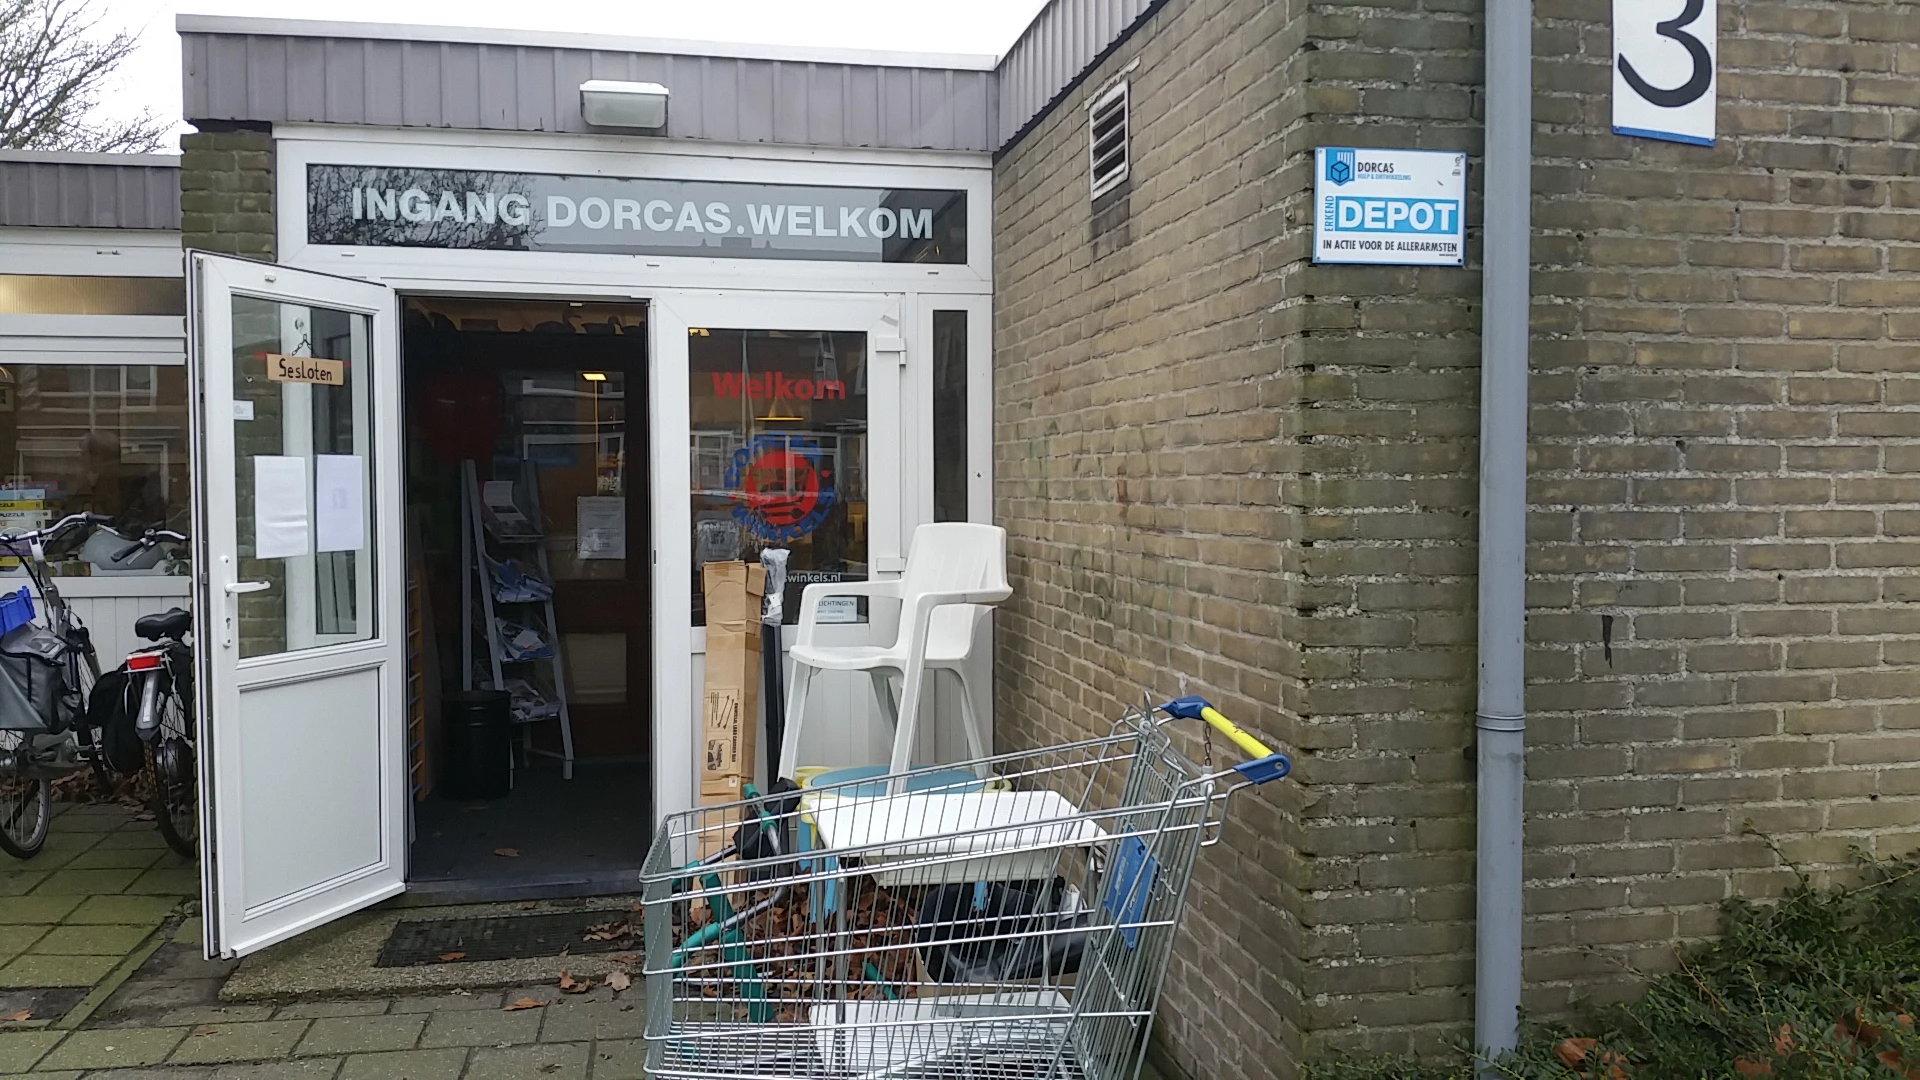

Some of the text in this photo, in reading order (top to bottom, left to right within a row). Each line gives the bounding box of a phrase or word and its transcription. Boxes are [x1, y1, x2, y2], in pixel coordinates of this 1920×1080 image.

[1618, 0, 1712, 108] 3
[1357, 162, 1394, 173] DORCAS
[352, 187, 531, 226] INGANG
[1324, 195, 1335, 232] ERKEND
[1339, 199, 1456, 230] DEPOT
[1323, 239, 1458, 252] IN ACTIE VOOR DE ALLERARMSTEN
[711, 371, 846, 400] Welkom
[785, 572, 841, 583] winkels.nl
